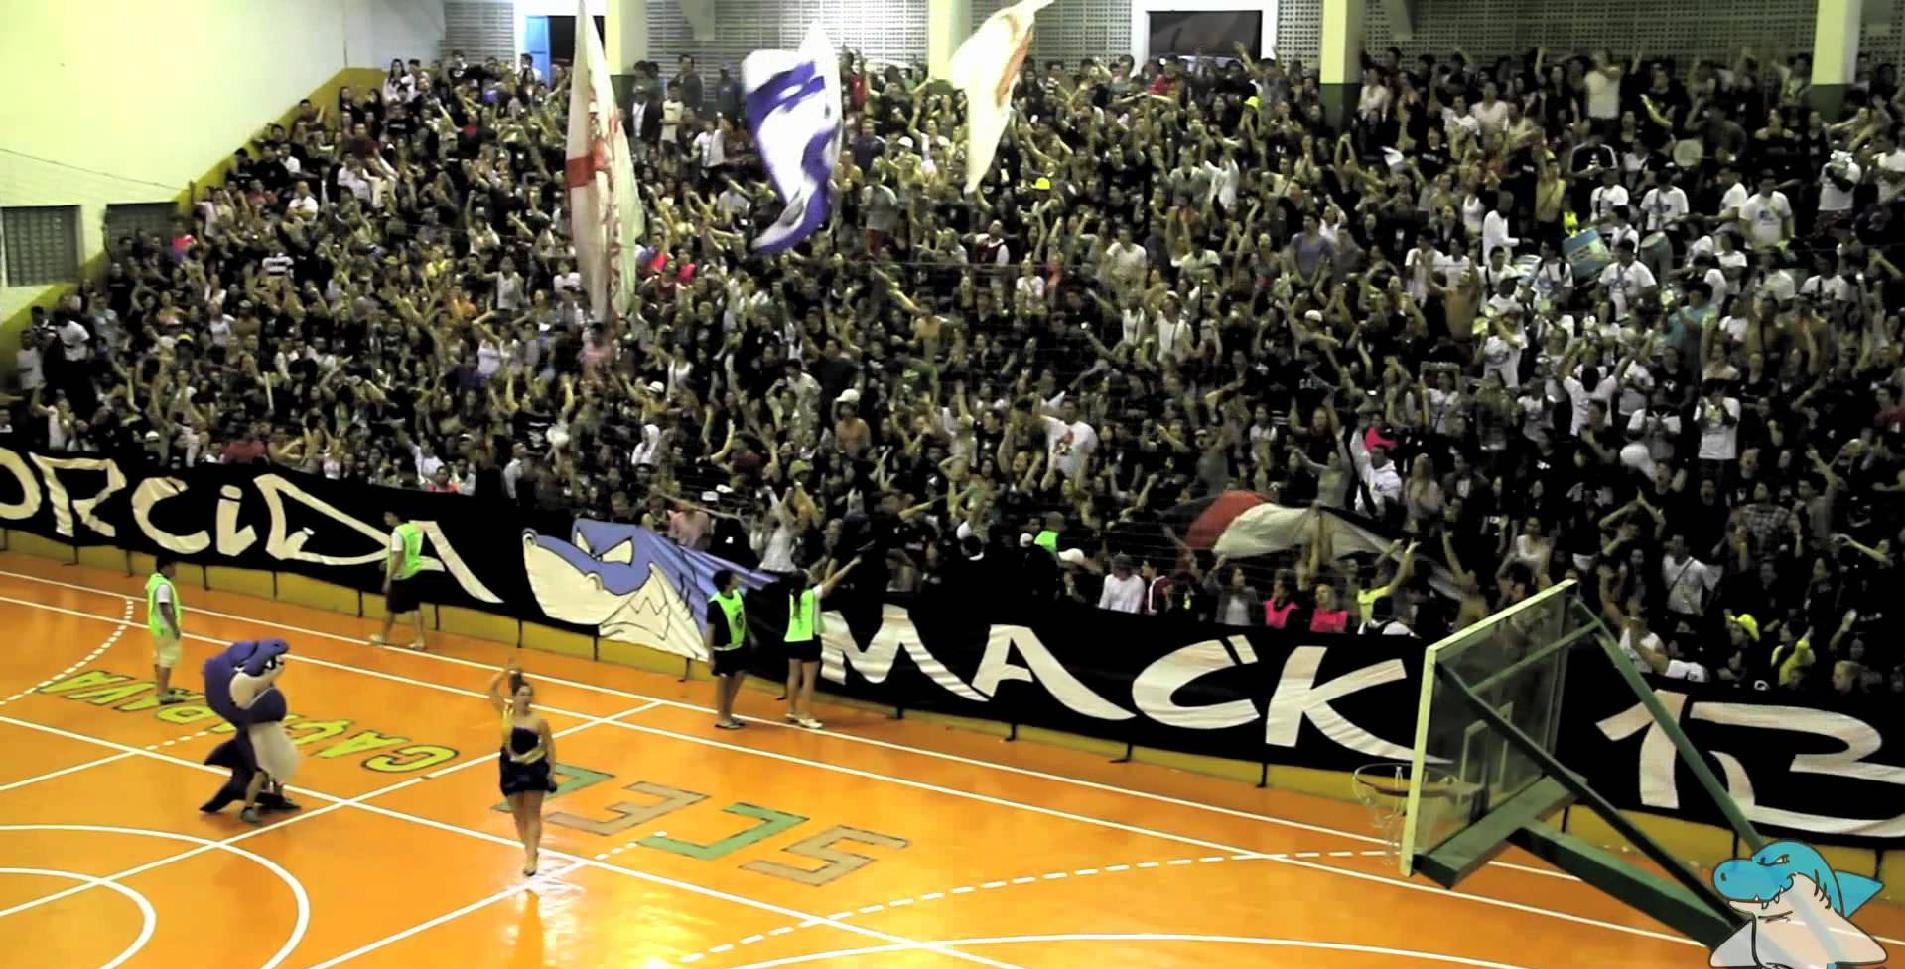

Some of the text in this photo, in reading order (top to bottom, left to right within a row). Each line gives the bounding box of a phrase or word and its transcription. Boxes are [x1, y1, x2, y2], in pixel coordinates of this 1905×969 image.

[35, 669, 461, 775] CAÇPAVA
[820, 604, 1454, 765] MACK
[1595, 688, 1905, 837] 13
